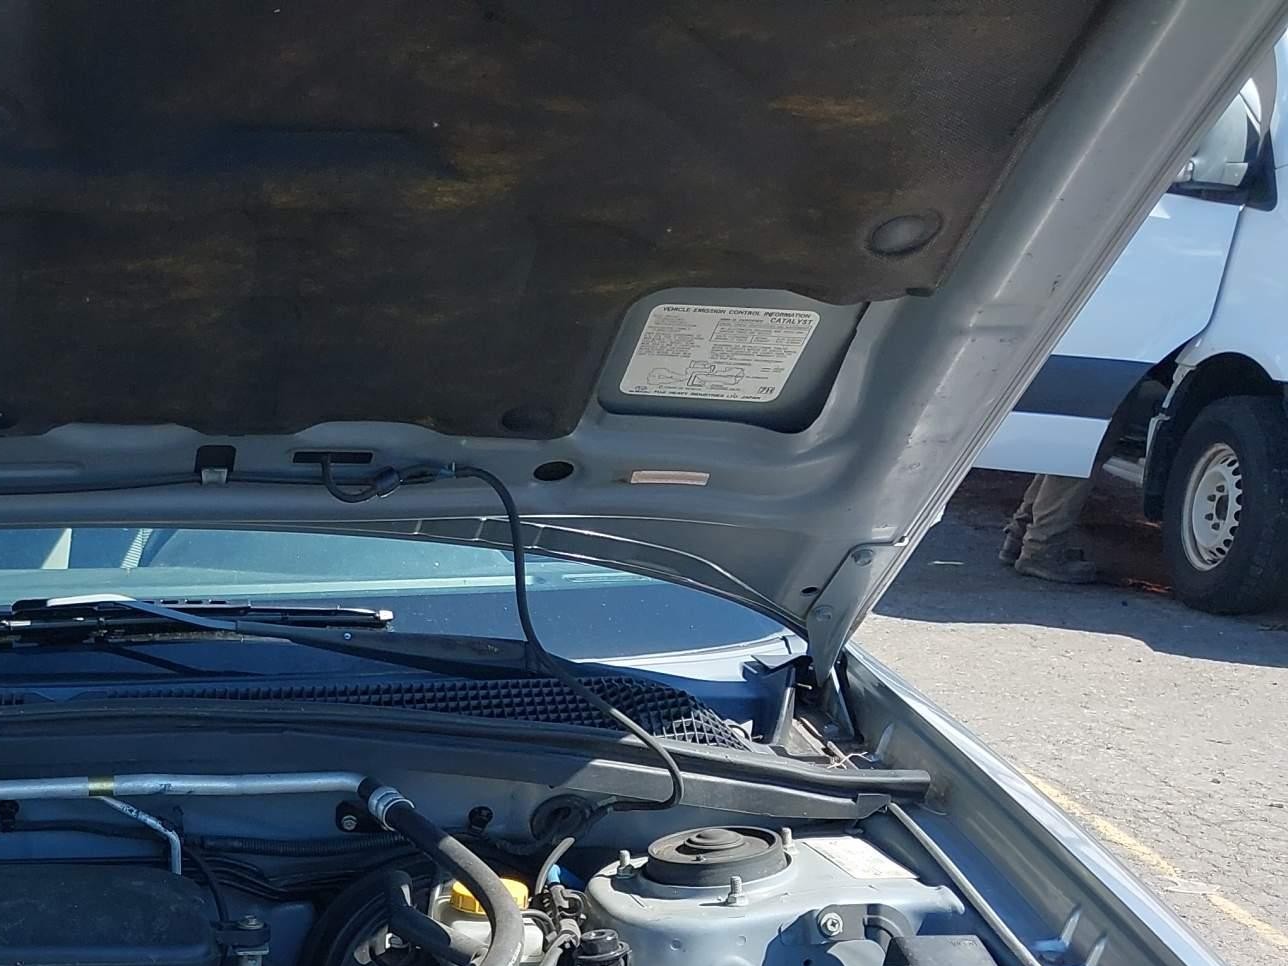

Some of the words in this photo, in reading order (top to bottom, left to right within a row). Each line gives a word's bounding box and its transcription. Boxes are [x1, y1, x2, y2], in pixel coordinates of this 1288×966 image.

[728, 309, 760, 317] CONTROL
[764, 311, 812, 319] INFORMATION
[770, 317, 814, 326] CATALYST
